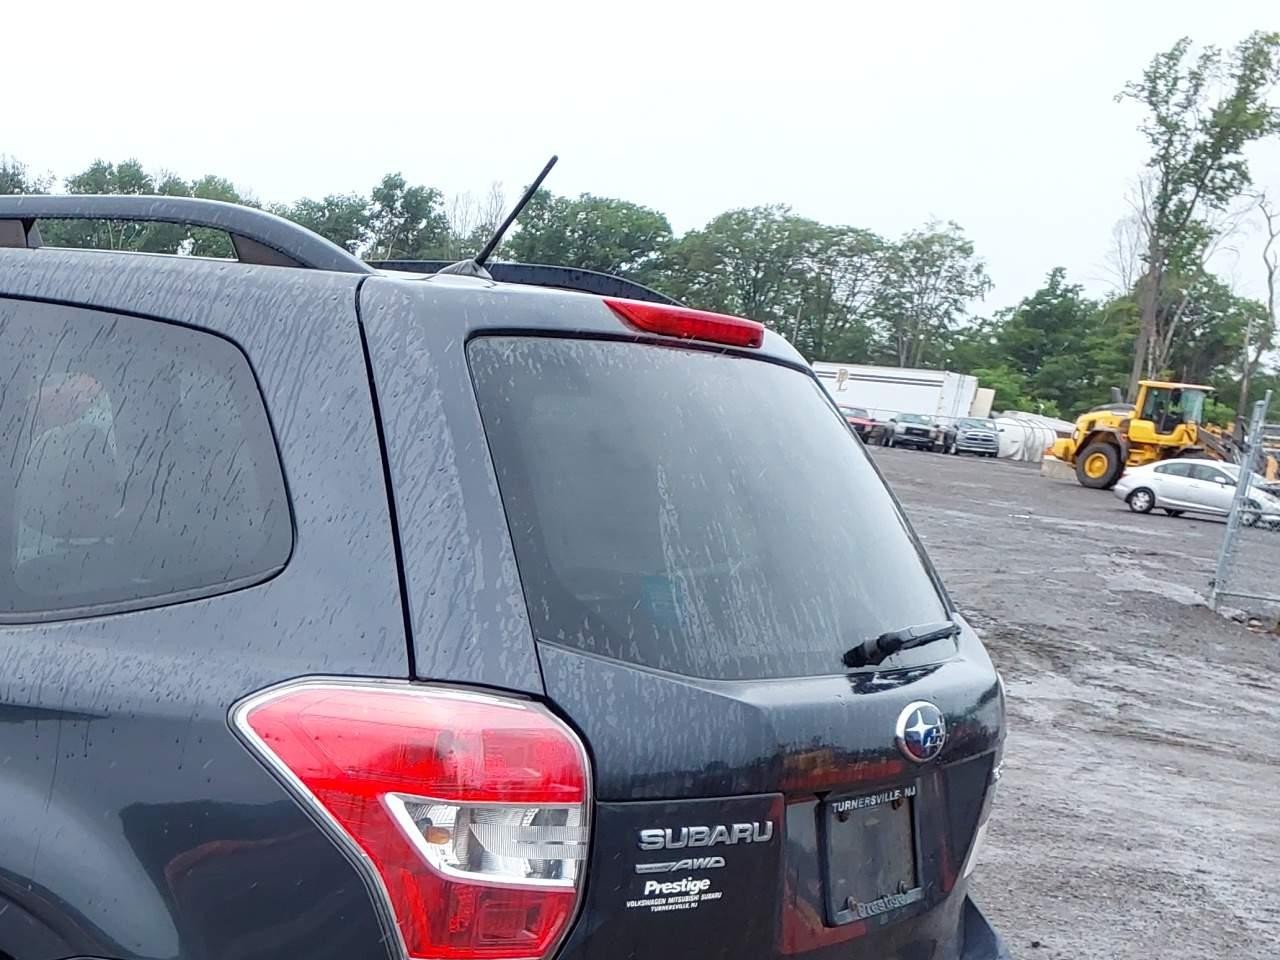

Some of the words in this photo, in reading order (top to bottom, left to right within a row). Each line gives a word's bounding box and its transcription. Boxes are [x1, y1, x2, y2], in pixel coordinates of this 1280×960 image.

[904, 785, 916, 798] NJ
[639, 821, 773, 850] SUBARU
[671, 856, 726, 872] AWD
[644, 877, 710, 894] Prestige
[626, 898, 667, 908] VOLKSWAGEN
[700, 891, 723, 901] SUBARU
